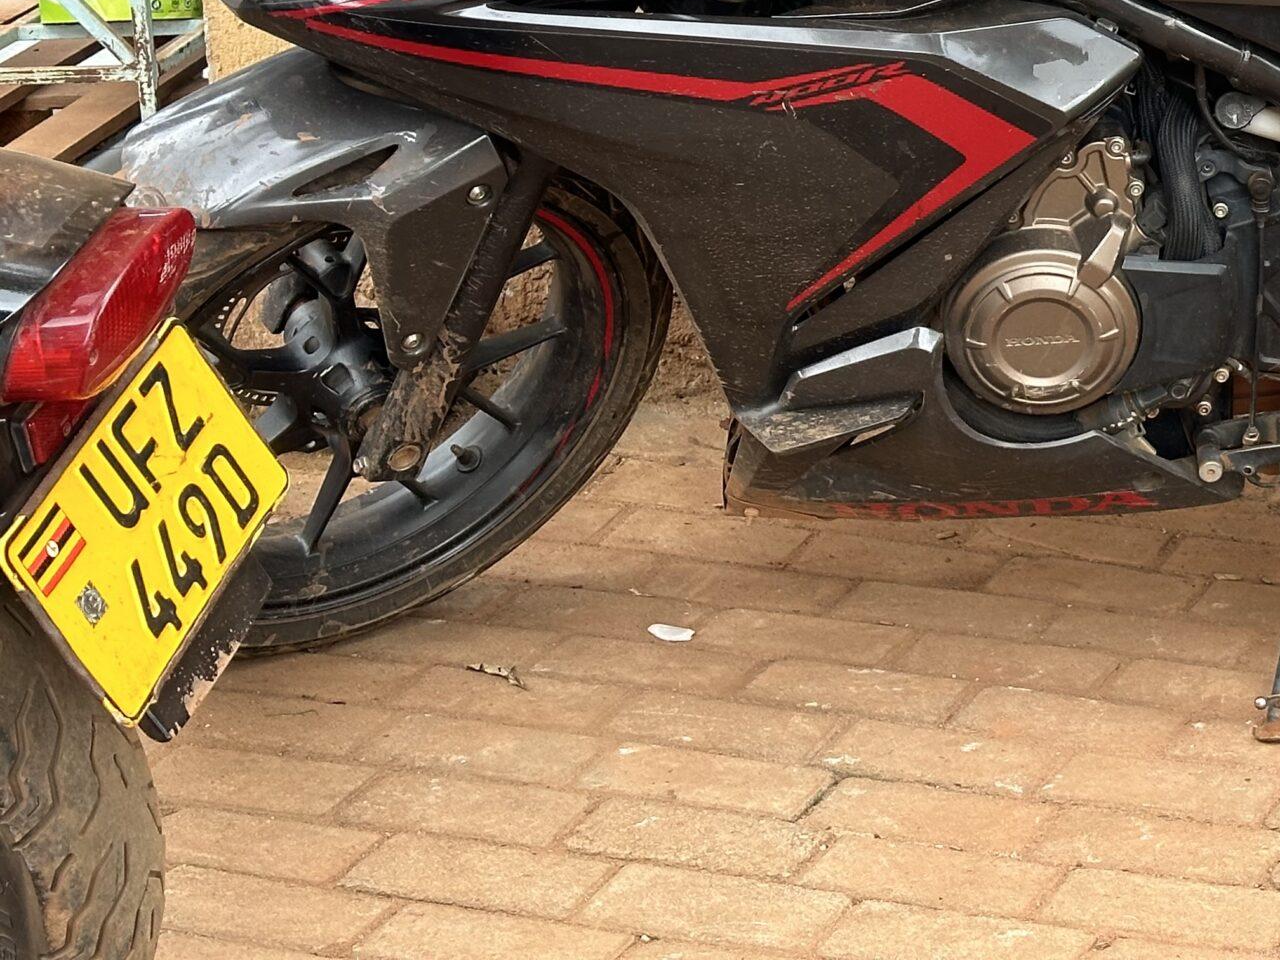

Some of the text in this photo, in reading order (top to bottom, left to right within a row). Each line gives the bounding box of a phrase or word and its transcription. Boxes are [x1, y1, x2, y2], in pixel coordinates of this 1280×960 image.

[1005, 335, 1081, 348] HONDA
[79, 361, 205, 529] UFZ
[131, 443, 260, 639] 449D
